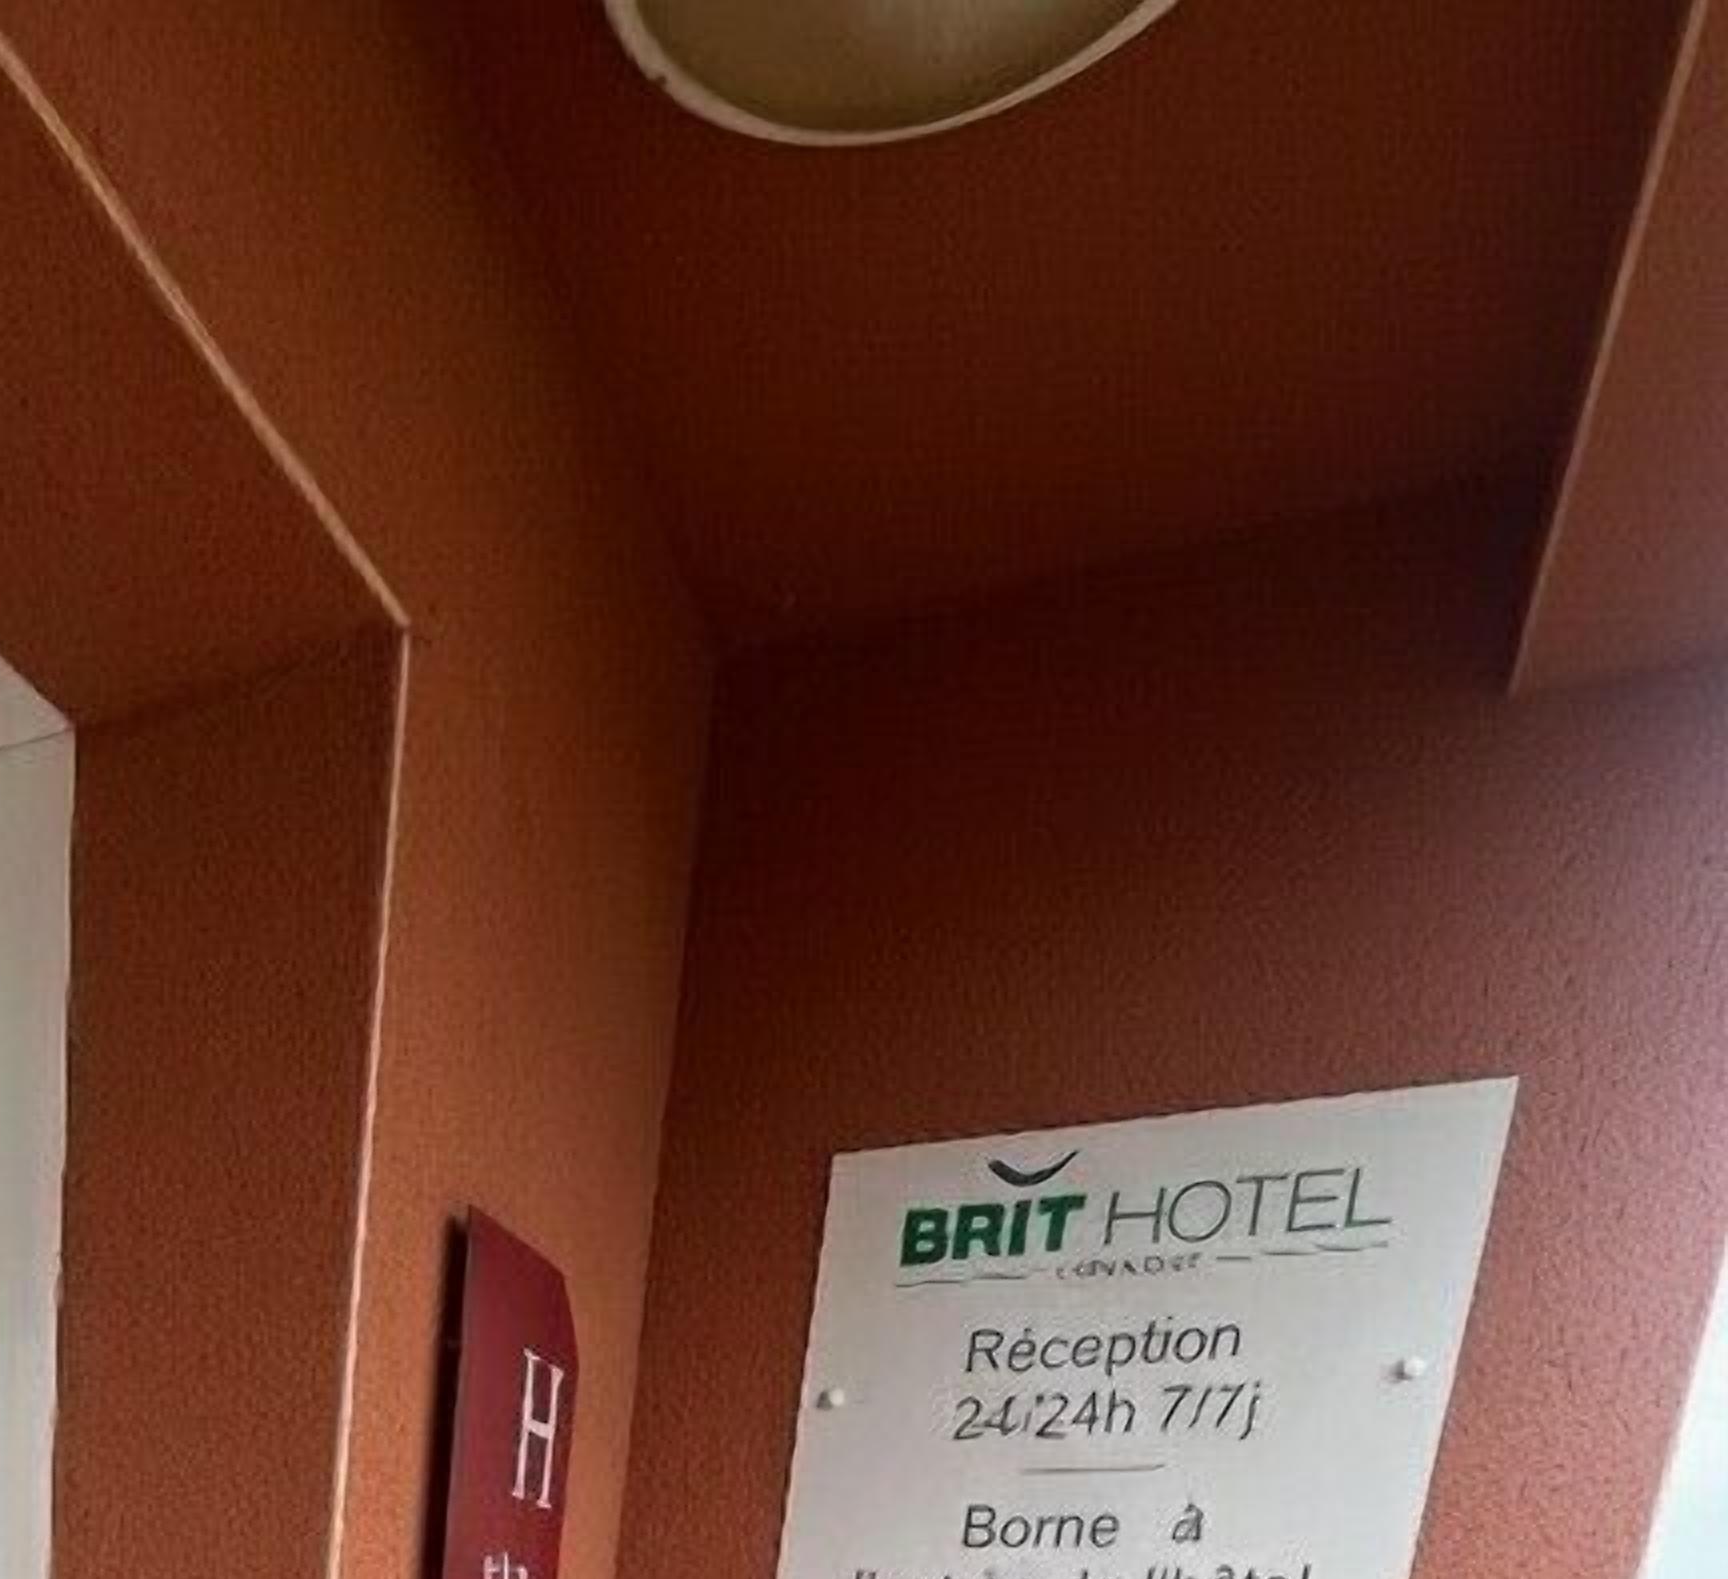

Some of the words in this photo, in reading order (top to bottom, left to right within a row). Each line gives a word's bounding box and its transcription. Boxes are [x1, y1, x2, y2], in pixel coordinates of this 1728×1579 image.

[899, 1194, 1085, 1267] BRIT
[1104, 1167, 1390, 1245] HOTEL
[965, 1319, 1241, 1376] Réception
[513, 1348, 564, 1508] H
[962, 1505, 1120, 1549] Borne
[1172, 1503, 1204, 1543] à
